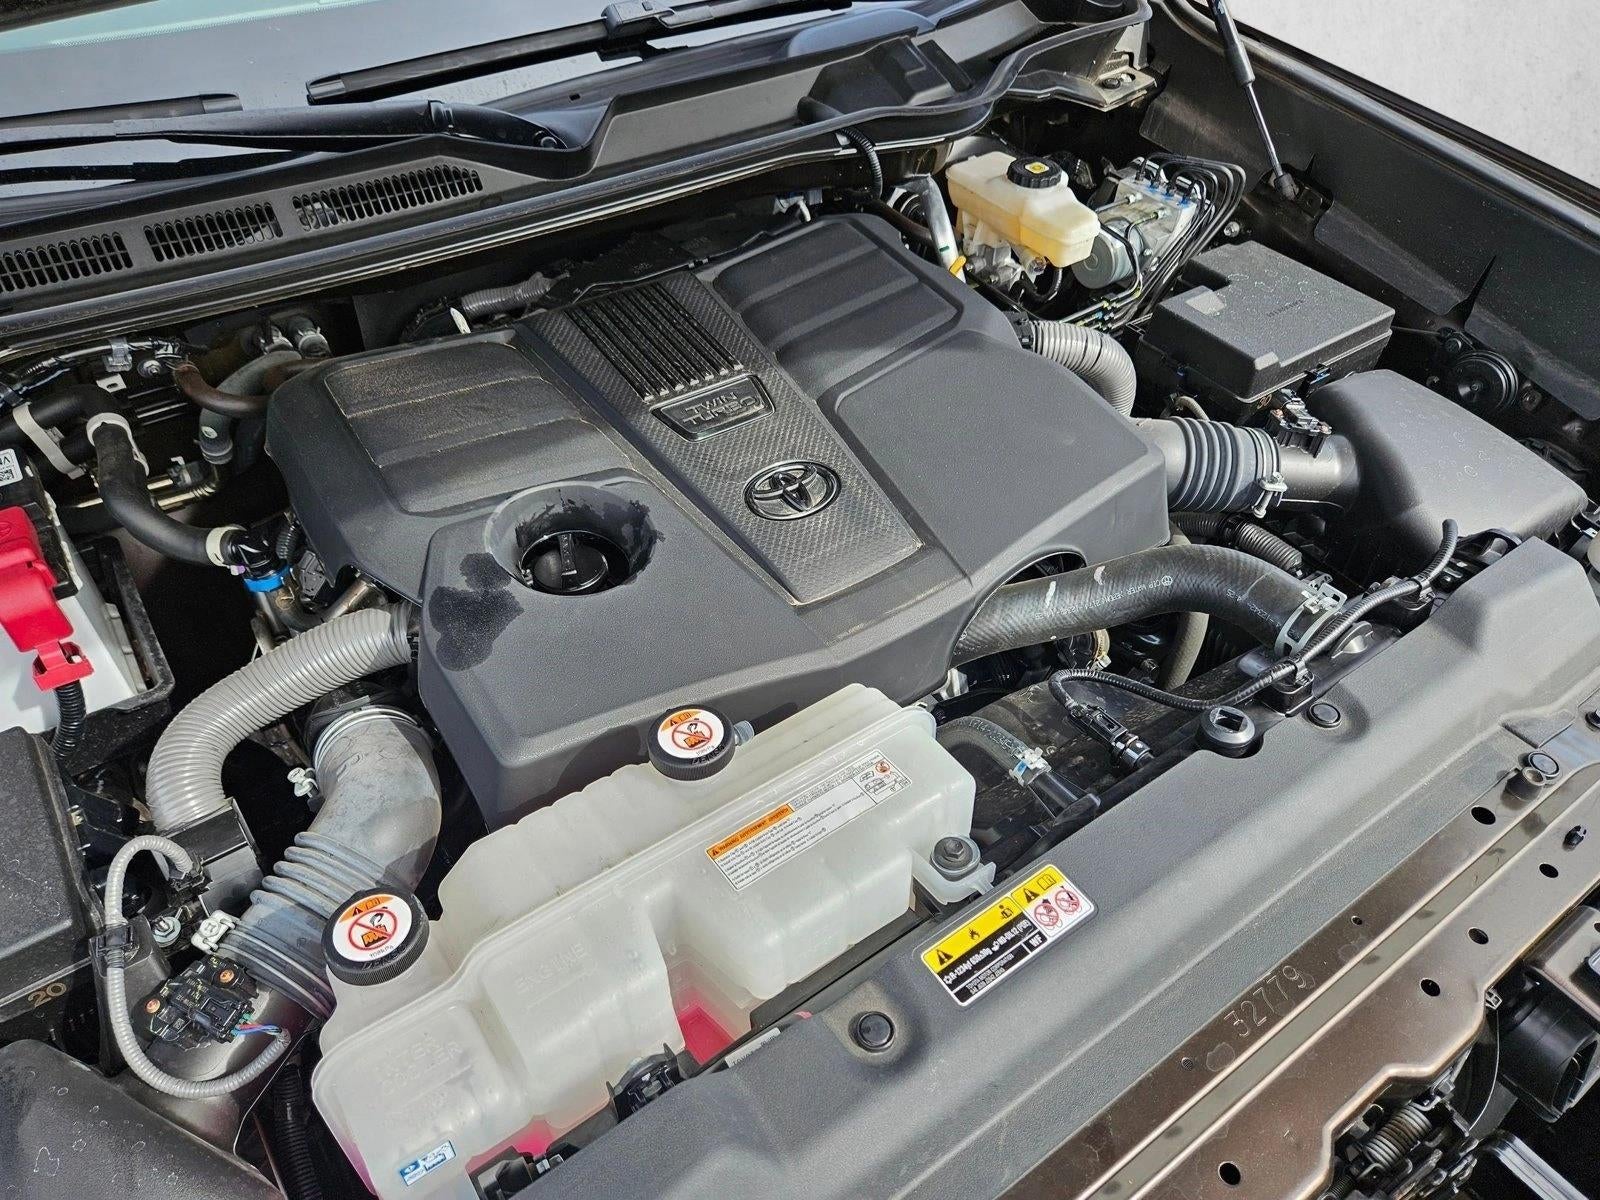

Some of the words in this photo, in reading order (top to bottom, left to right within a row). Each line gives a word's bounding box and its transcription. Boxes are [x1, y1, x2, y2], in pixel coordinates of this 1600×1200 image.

[682, 395, 757, 424] TURBO
[684, 392, 737, 414] TWIN
[1125, 582, 1147, 596] WATER
[1029, 934, 1042, 948] WF
[28, 982, 67, 1008] 20
[1223, 965, 1306, 1037] 32779
